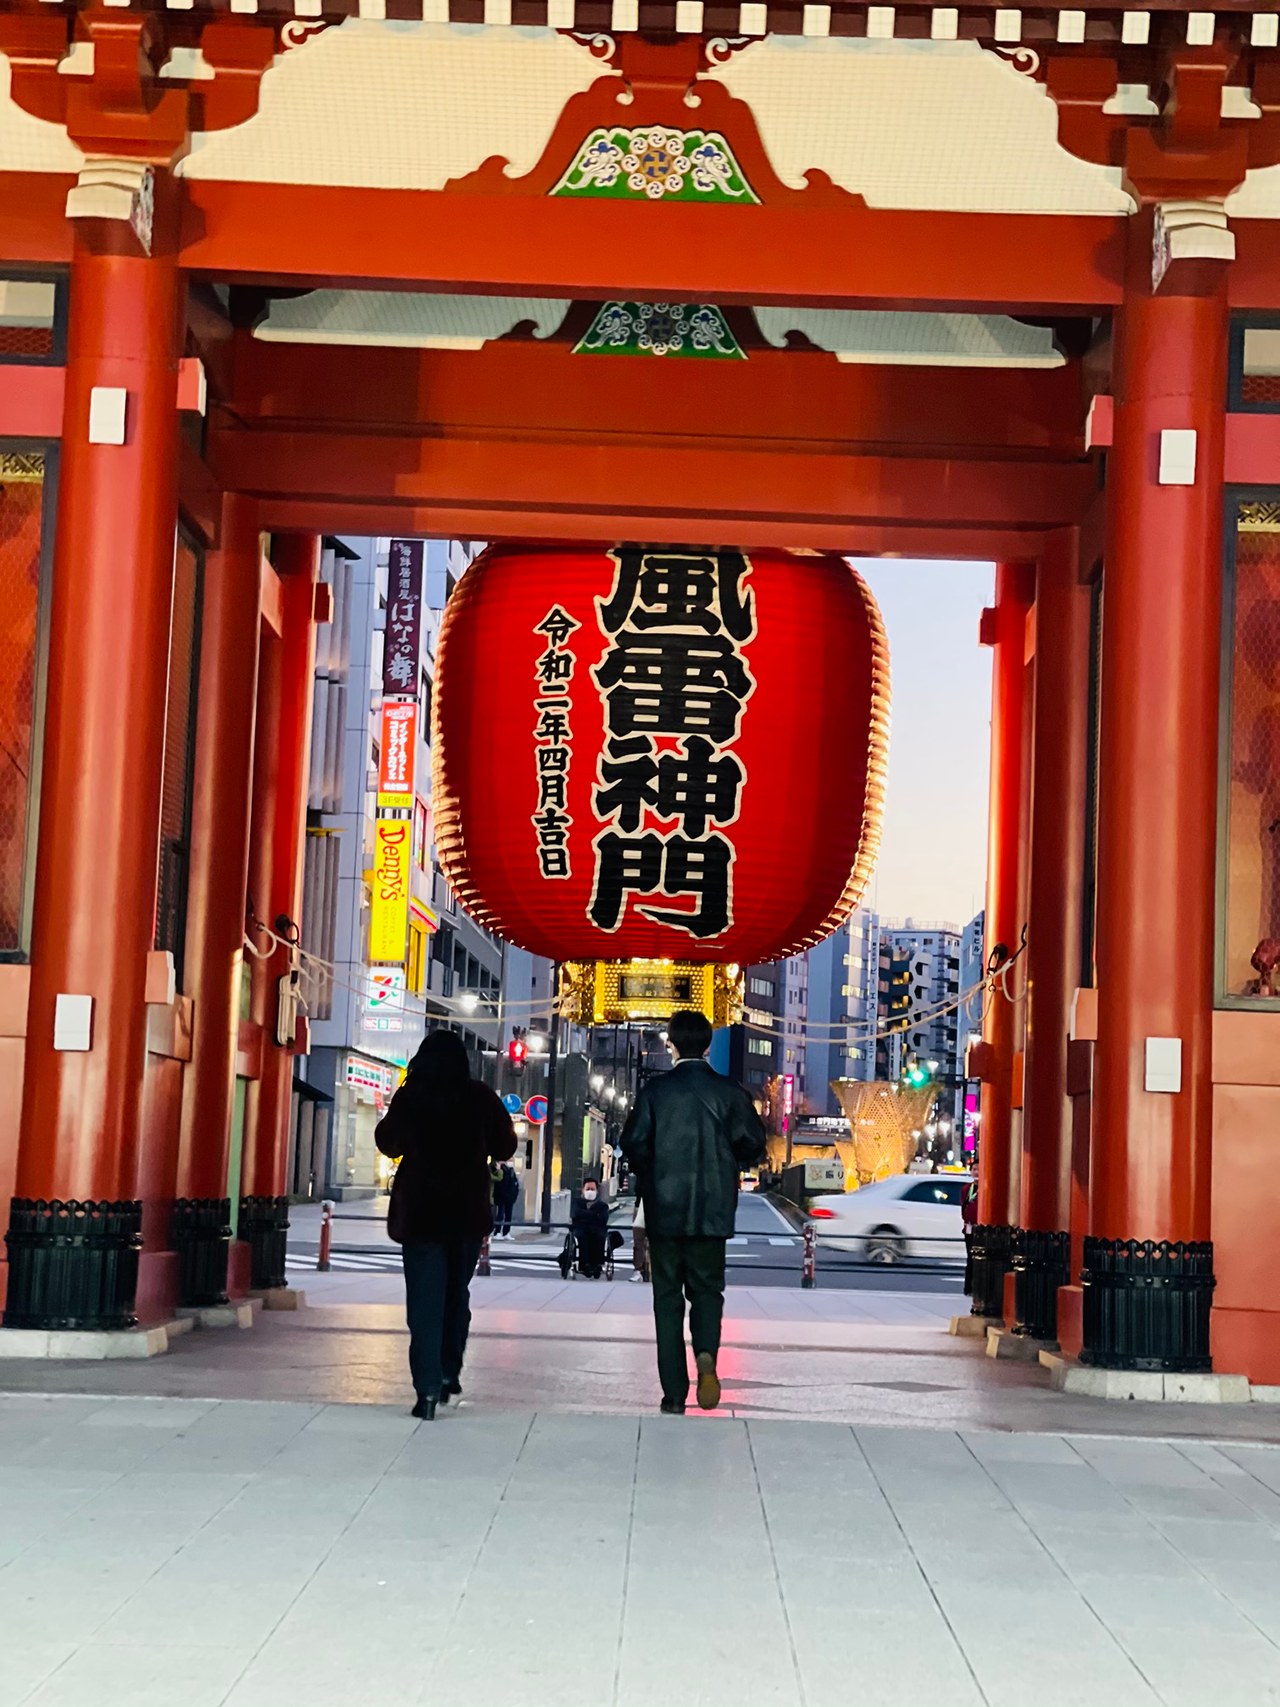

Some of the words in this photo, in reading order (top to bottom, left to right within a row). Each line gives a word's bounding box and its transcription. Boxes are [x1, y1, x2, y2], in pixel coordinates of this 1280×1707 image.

[377, 826, 405, 901] Denny's
[532, 604, 581, 880] 令和二年四月吉日
[586, 548, 758, 938] 風雷神門
